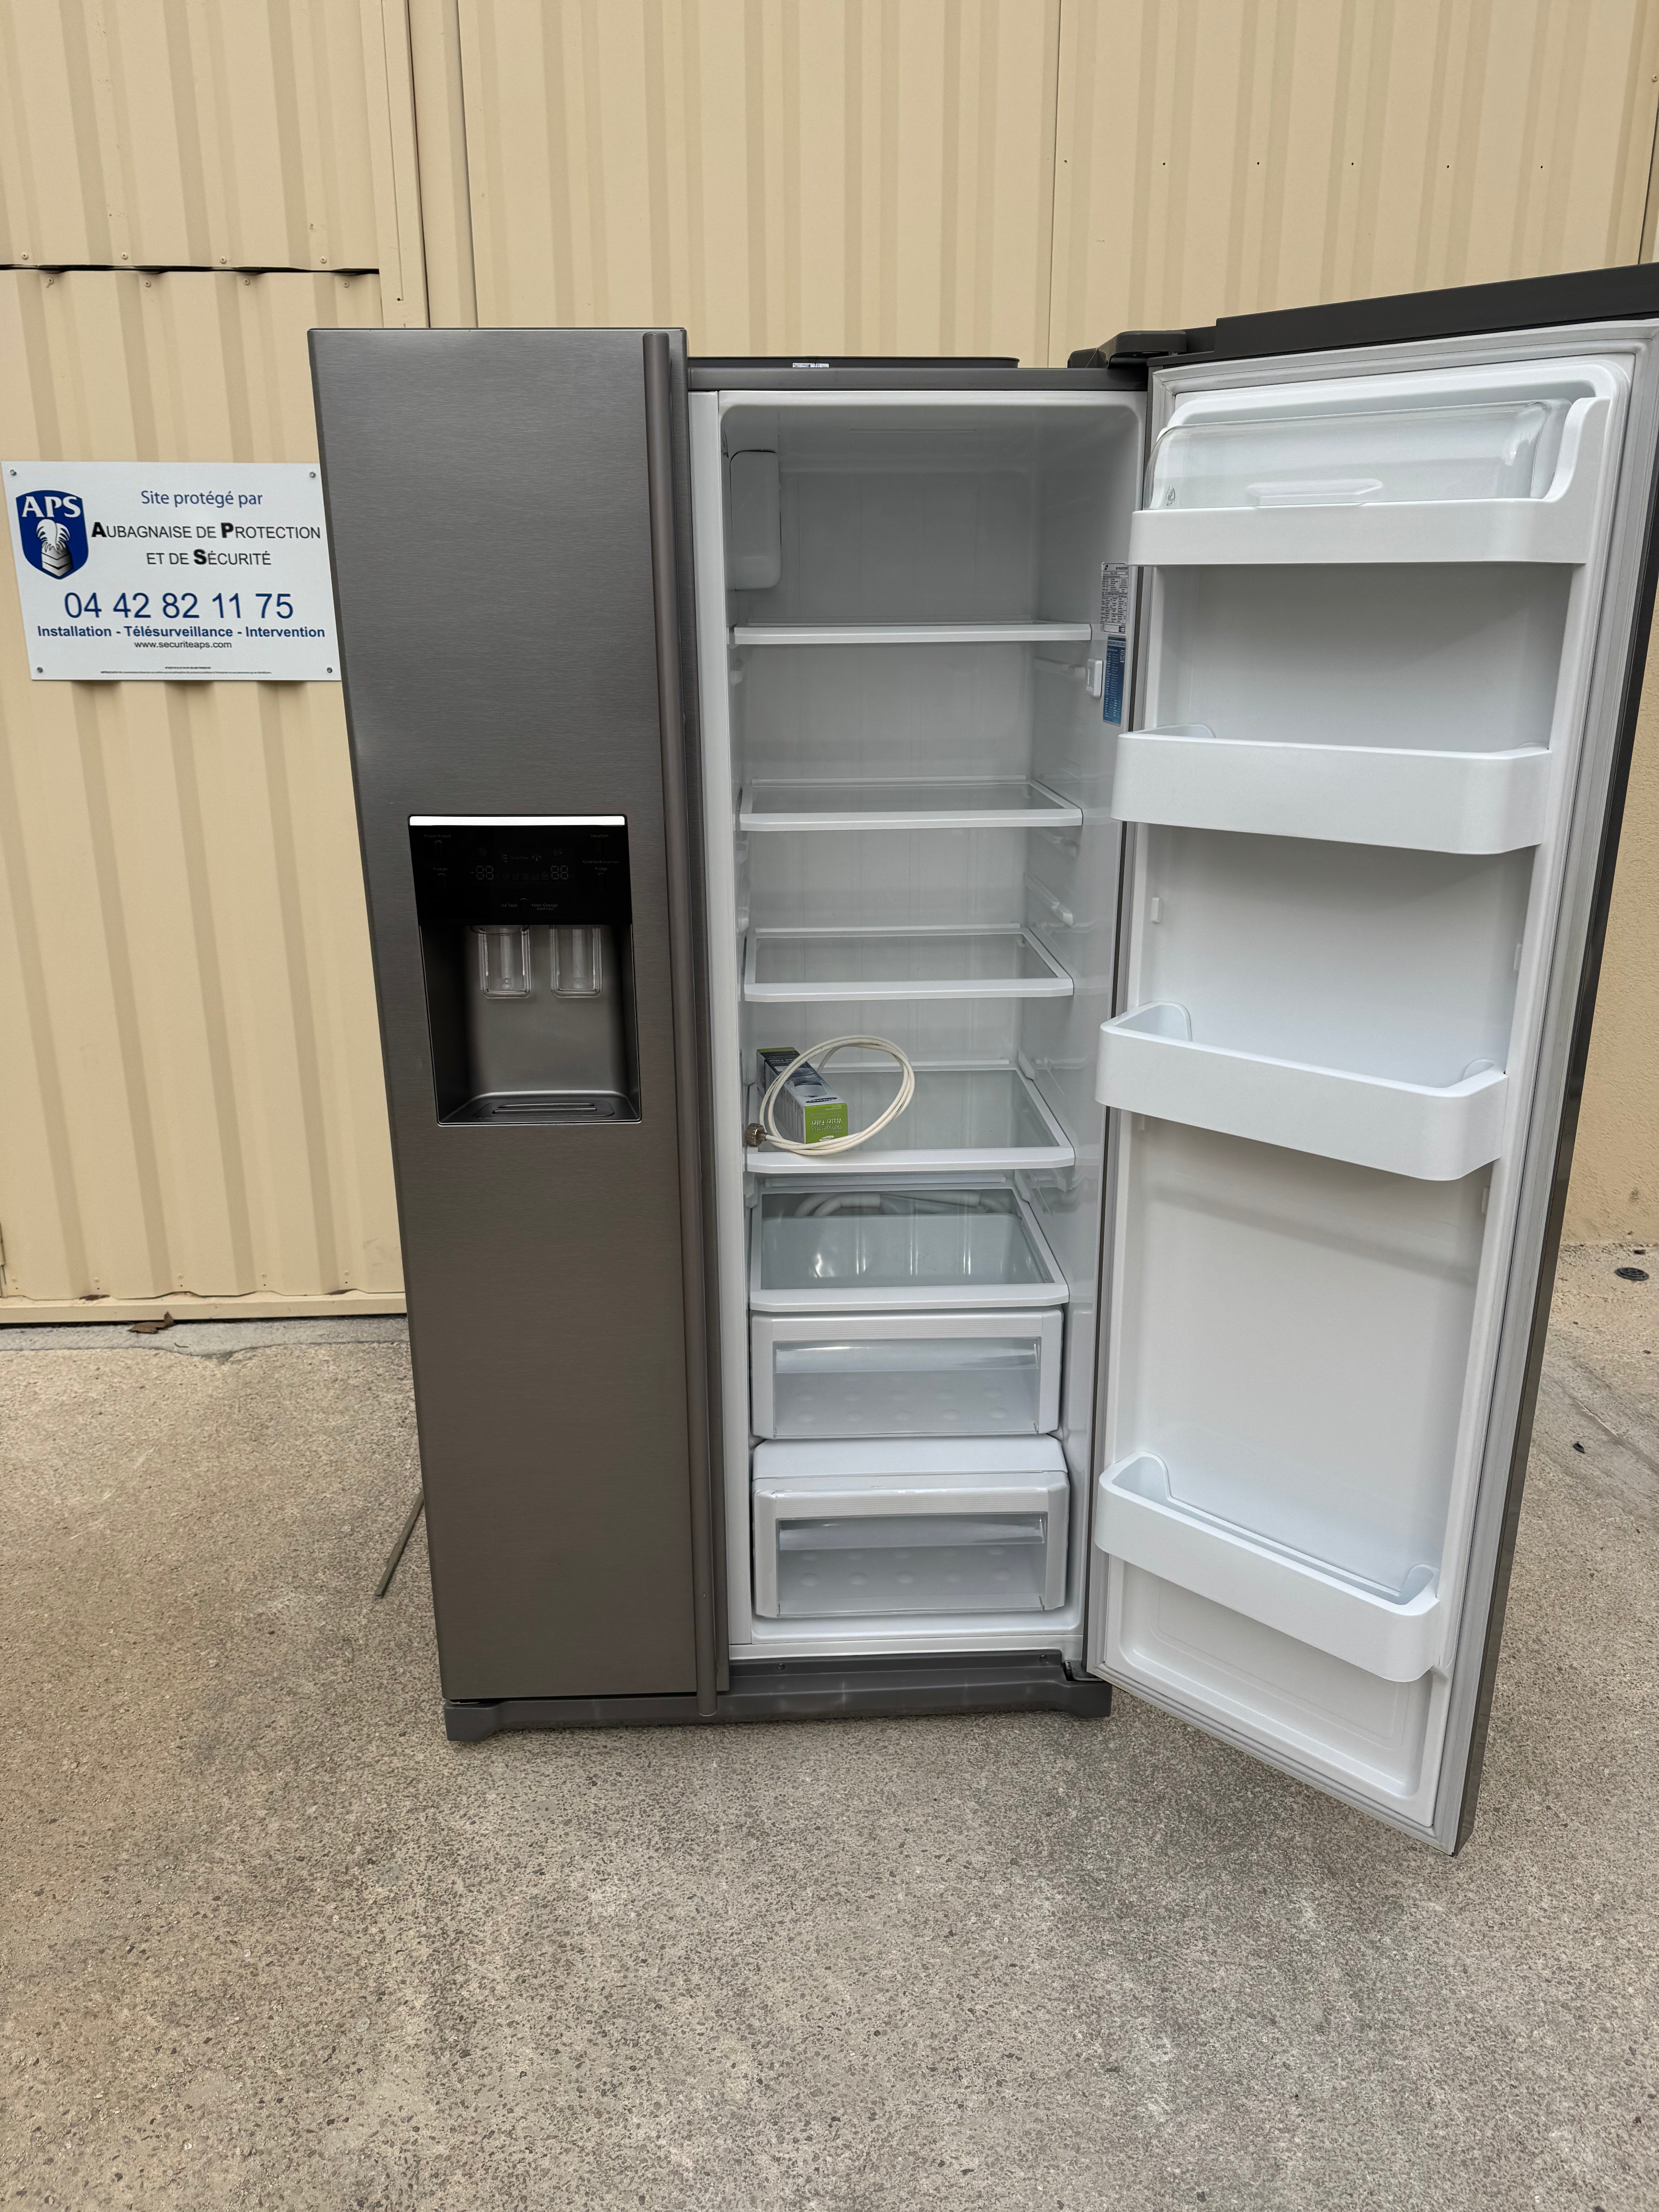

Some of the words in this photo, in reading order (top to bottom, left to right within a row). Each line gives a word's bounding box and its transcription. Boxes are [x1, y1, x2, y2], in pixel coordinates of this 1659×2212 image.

[21, 495, 82, 518] APS
[141, 490, 170, 505] Site
[173, 490, 234, 508] protégé
[238, 494, 263, 508] par
[91, 521, 192, 538] AUBAGNAISE
[196, 526, 217, 538] DE
[220, 522, 321, 539] PROTECTION
[146, 552, 165, 565] ET
[169, 552, 190, 565] DE
[193, 548, 272, 565] SÉCURITÉ
[64, 592, 103, 618] 04
[113, 592, 151, 618] 42
[162, 592, 200, 619] 82
[212, 592, 241, 619] 11
[255, 593, 294, 619] 75
[37, 625, 112, 637] Installation
[123, 625, 234, 637] Télésurveillance
[246, 626, 326, 638] Intervention
[134, 640, 232, 650] www.securiteaps.com
